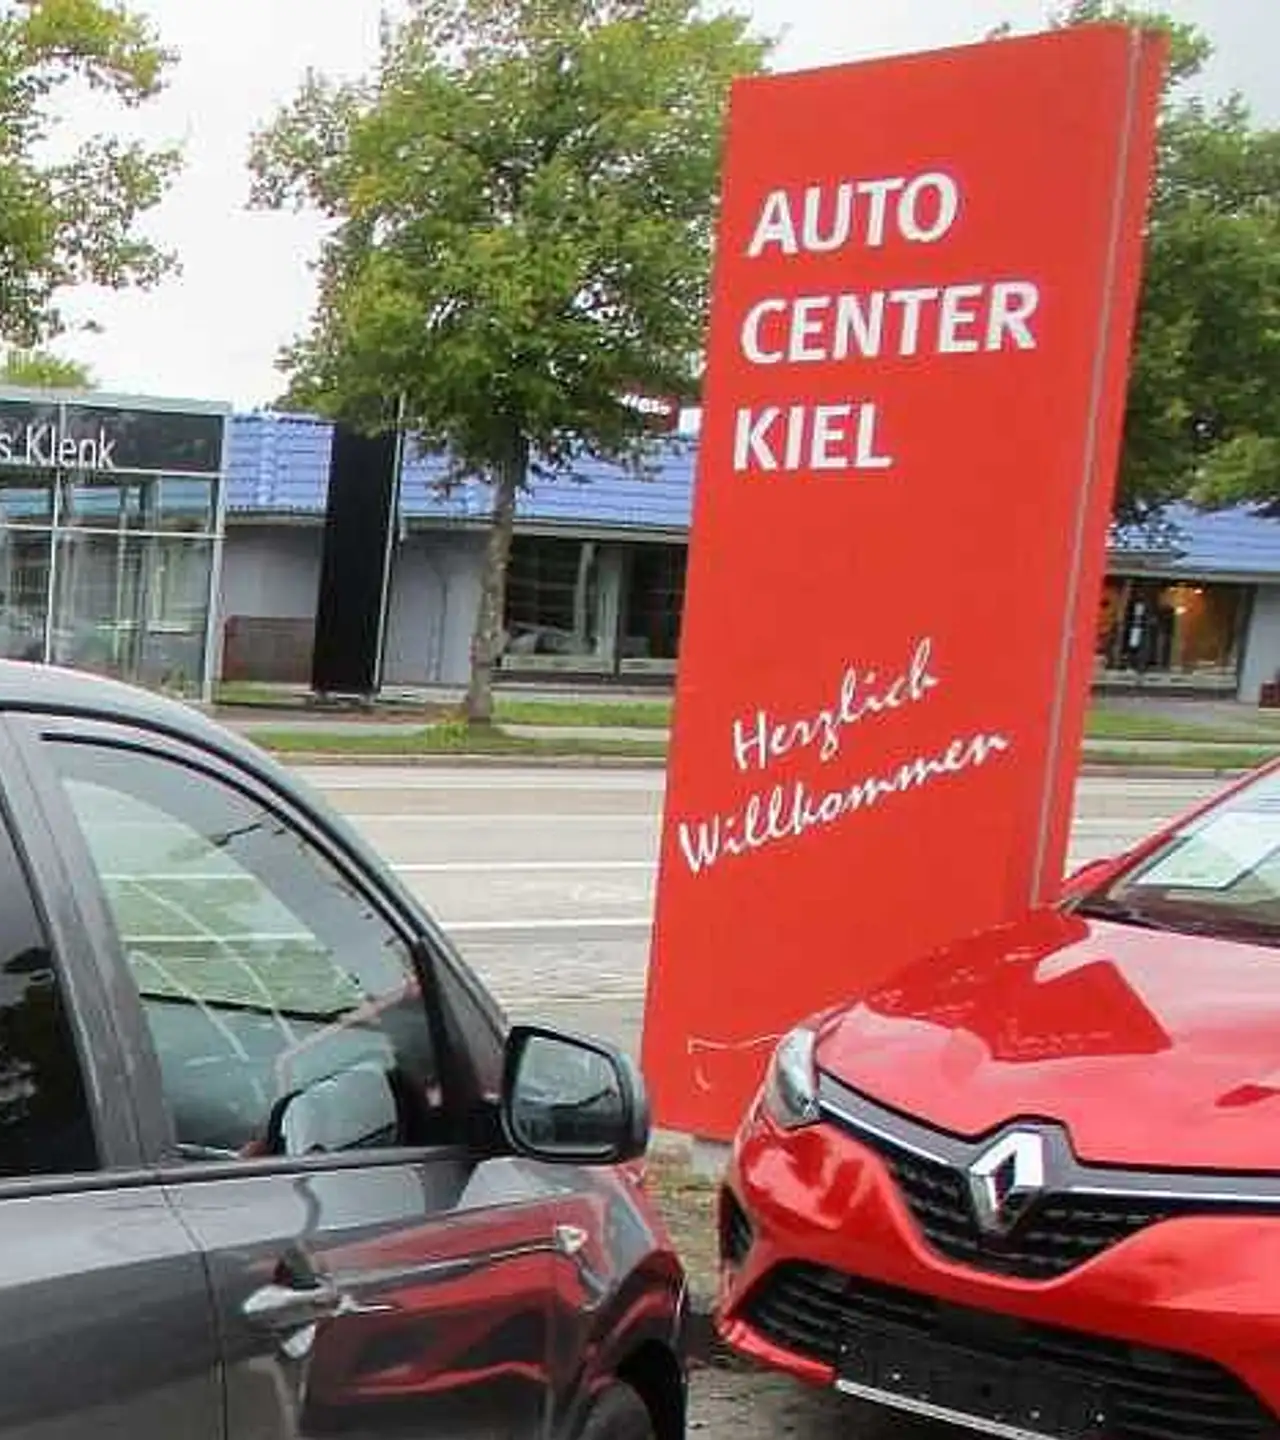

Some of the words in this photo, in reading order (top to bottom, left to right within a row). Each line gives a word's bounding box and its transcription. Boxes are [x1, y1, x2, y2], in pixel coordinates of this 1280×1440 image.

[747, 171, 958, 258] AUTO
[742, 280, 1039, 364] CENTER
[26, 424, 117, 469] Klenk
[734, 402, 893, 471] KIEL
[732, 636, 938, 770] Herzlich
[679, 732, 1010, 873] Willkommen
